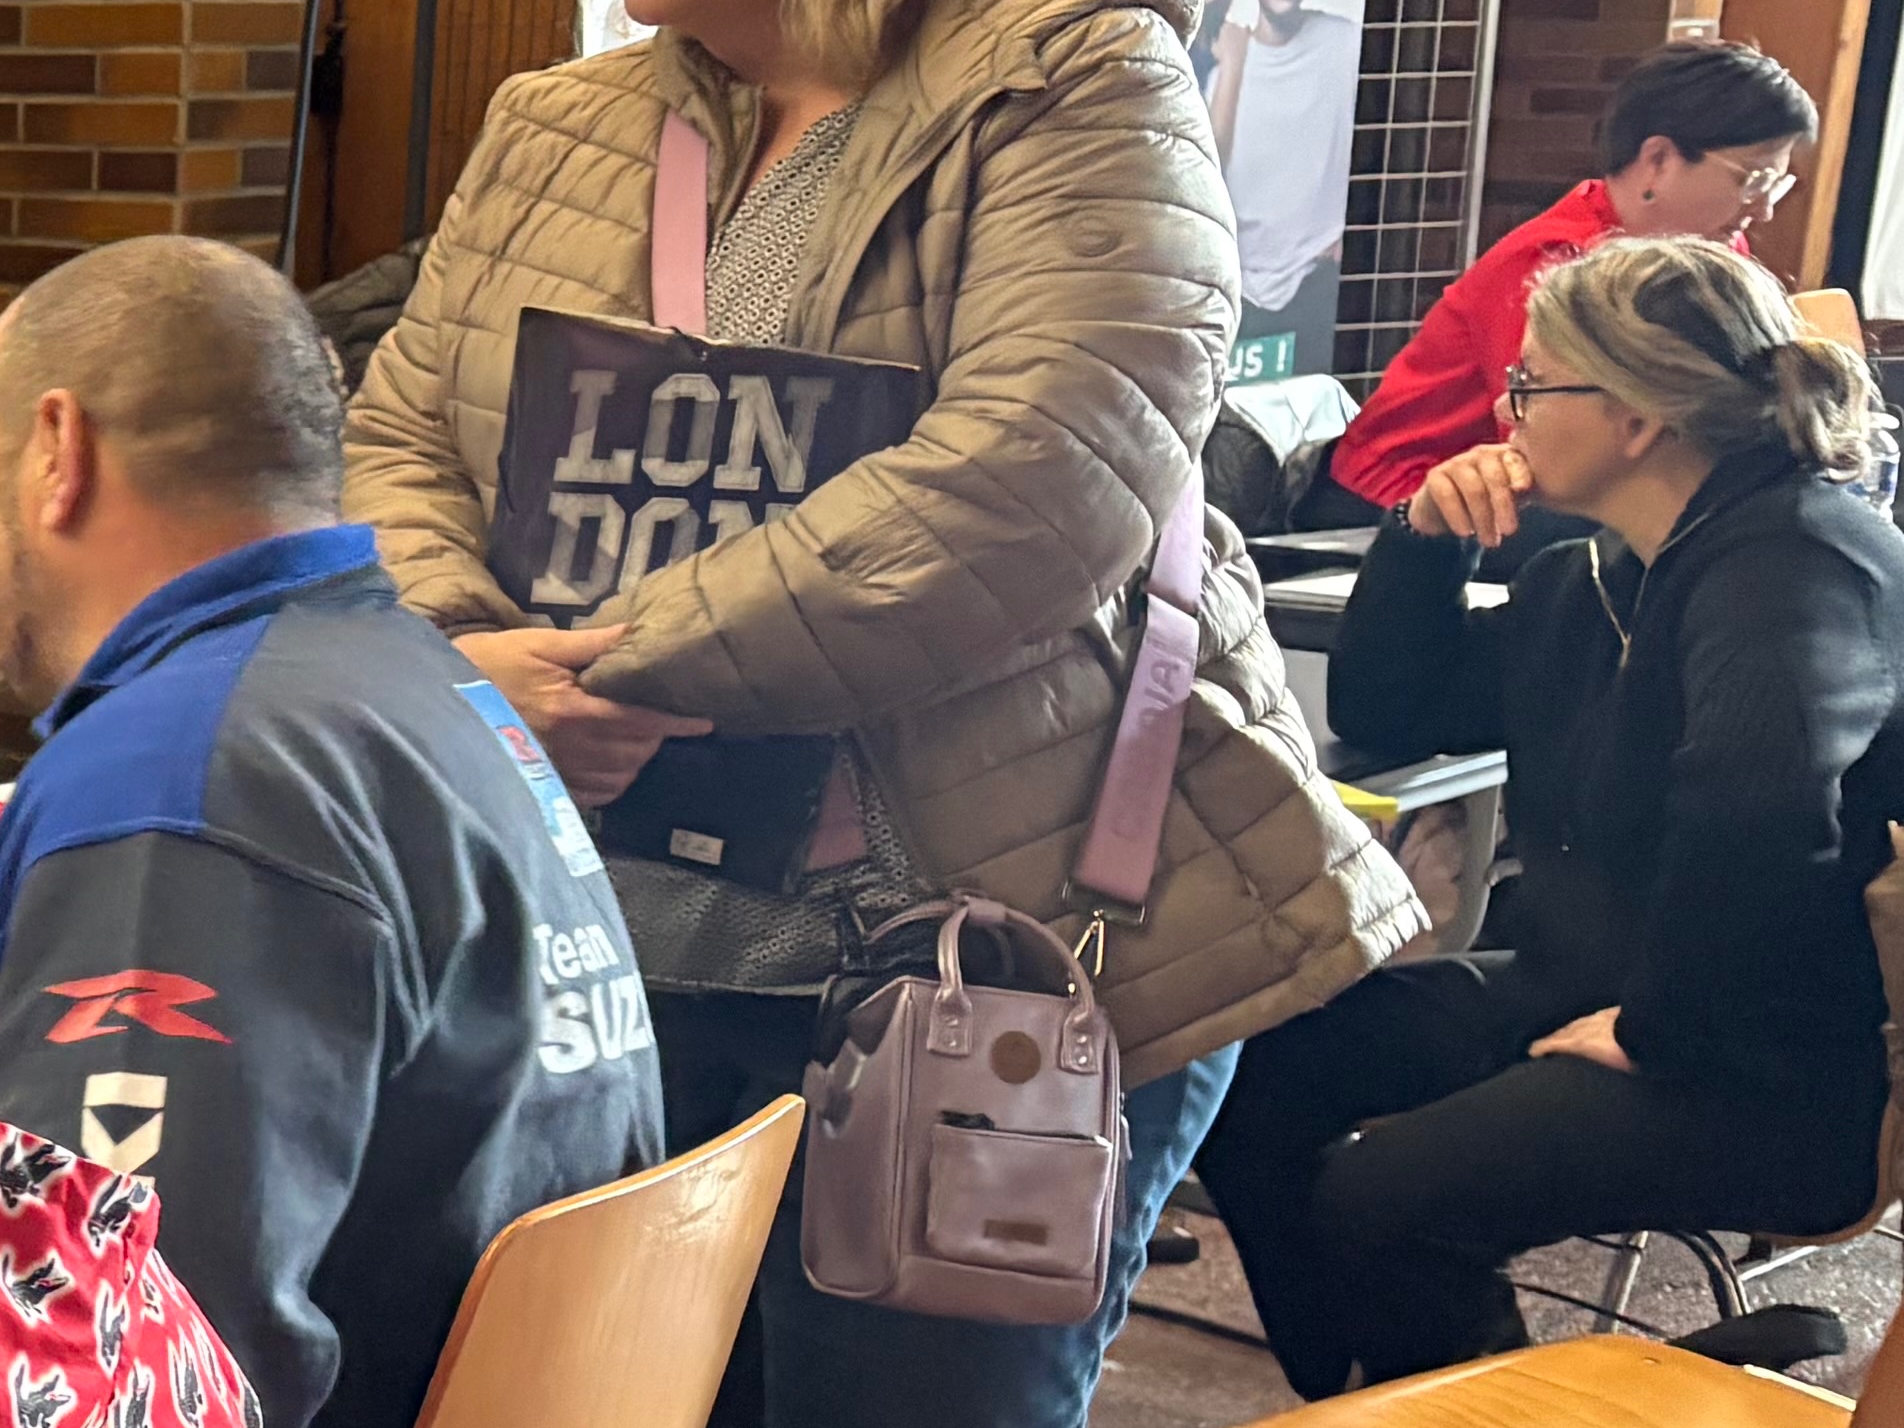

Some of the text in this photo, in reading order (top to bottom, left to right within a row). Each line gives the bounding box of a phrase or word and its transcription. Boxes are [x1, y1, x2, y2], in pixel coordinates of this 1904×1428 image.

[1228, 342, 1263, 378] US
[553, 370, 835, 493] LON
[530, 492, 799, 606] DO
[538, 971, 656, 1074] SUZ
